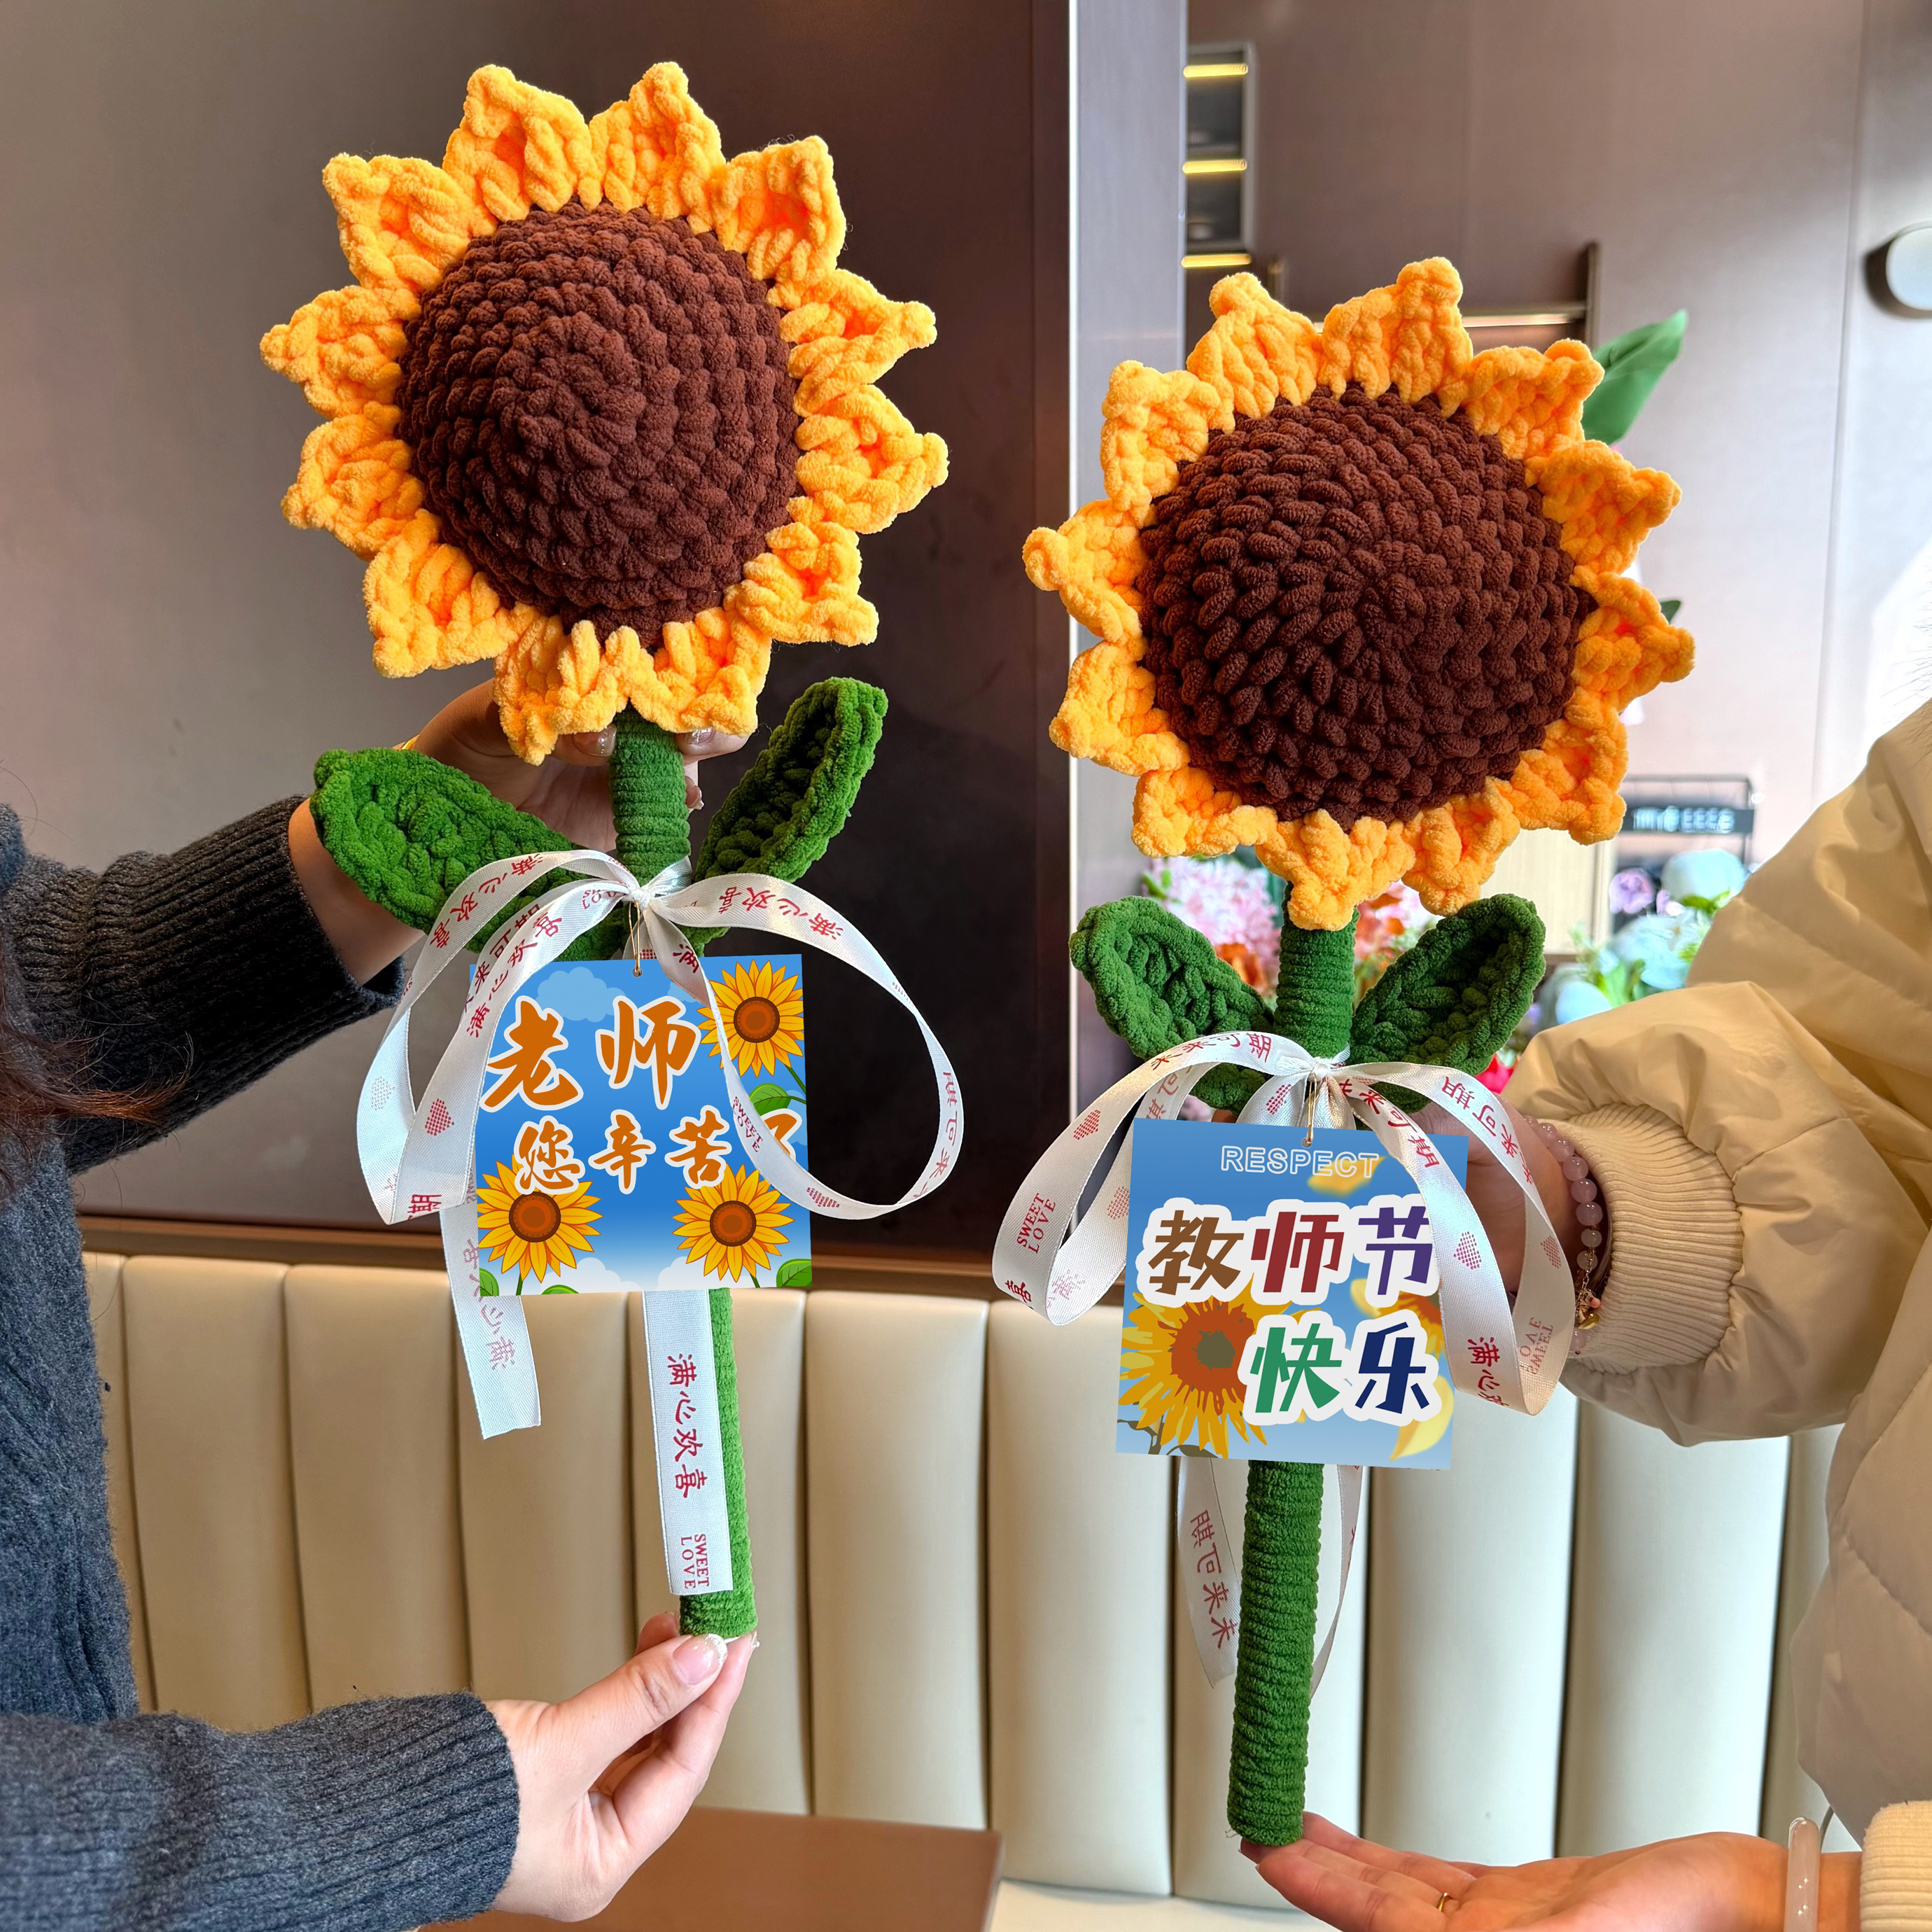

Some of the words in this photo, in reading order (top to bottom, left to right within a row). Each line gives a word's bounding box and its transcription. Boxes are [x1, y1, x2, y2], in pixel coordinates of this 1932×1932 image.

[429, 853, 543, 948] 满心欢喜
[718, 886, 844, 940] 满心欢喜
[466, 911, 563, 1038] 满心欢喜
[483, 998, 699, 1110] 老师
[1150, 1032, 1273, 1071] 未来可期
[732, 1096, 764, 1143] SWEET
[1219, 1145, 1380, 1179] RESPECT
[1016, 1192, 1045, 1248] SWEET
[1028, 1198, 1057, 1254] LOVE
[1146, 1204, 1435, 1297] 教师节
[1250, 1321, 1431, 1415] 快乐
[666, 1353, 708, 1499] 满心欢喜
[680, 1535, 696, 1590] LOVE
[693, 1532, 710, 1588] SWEET
